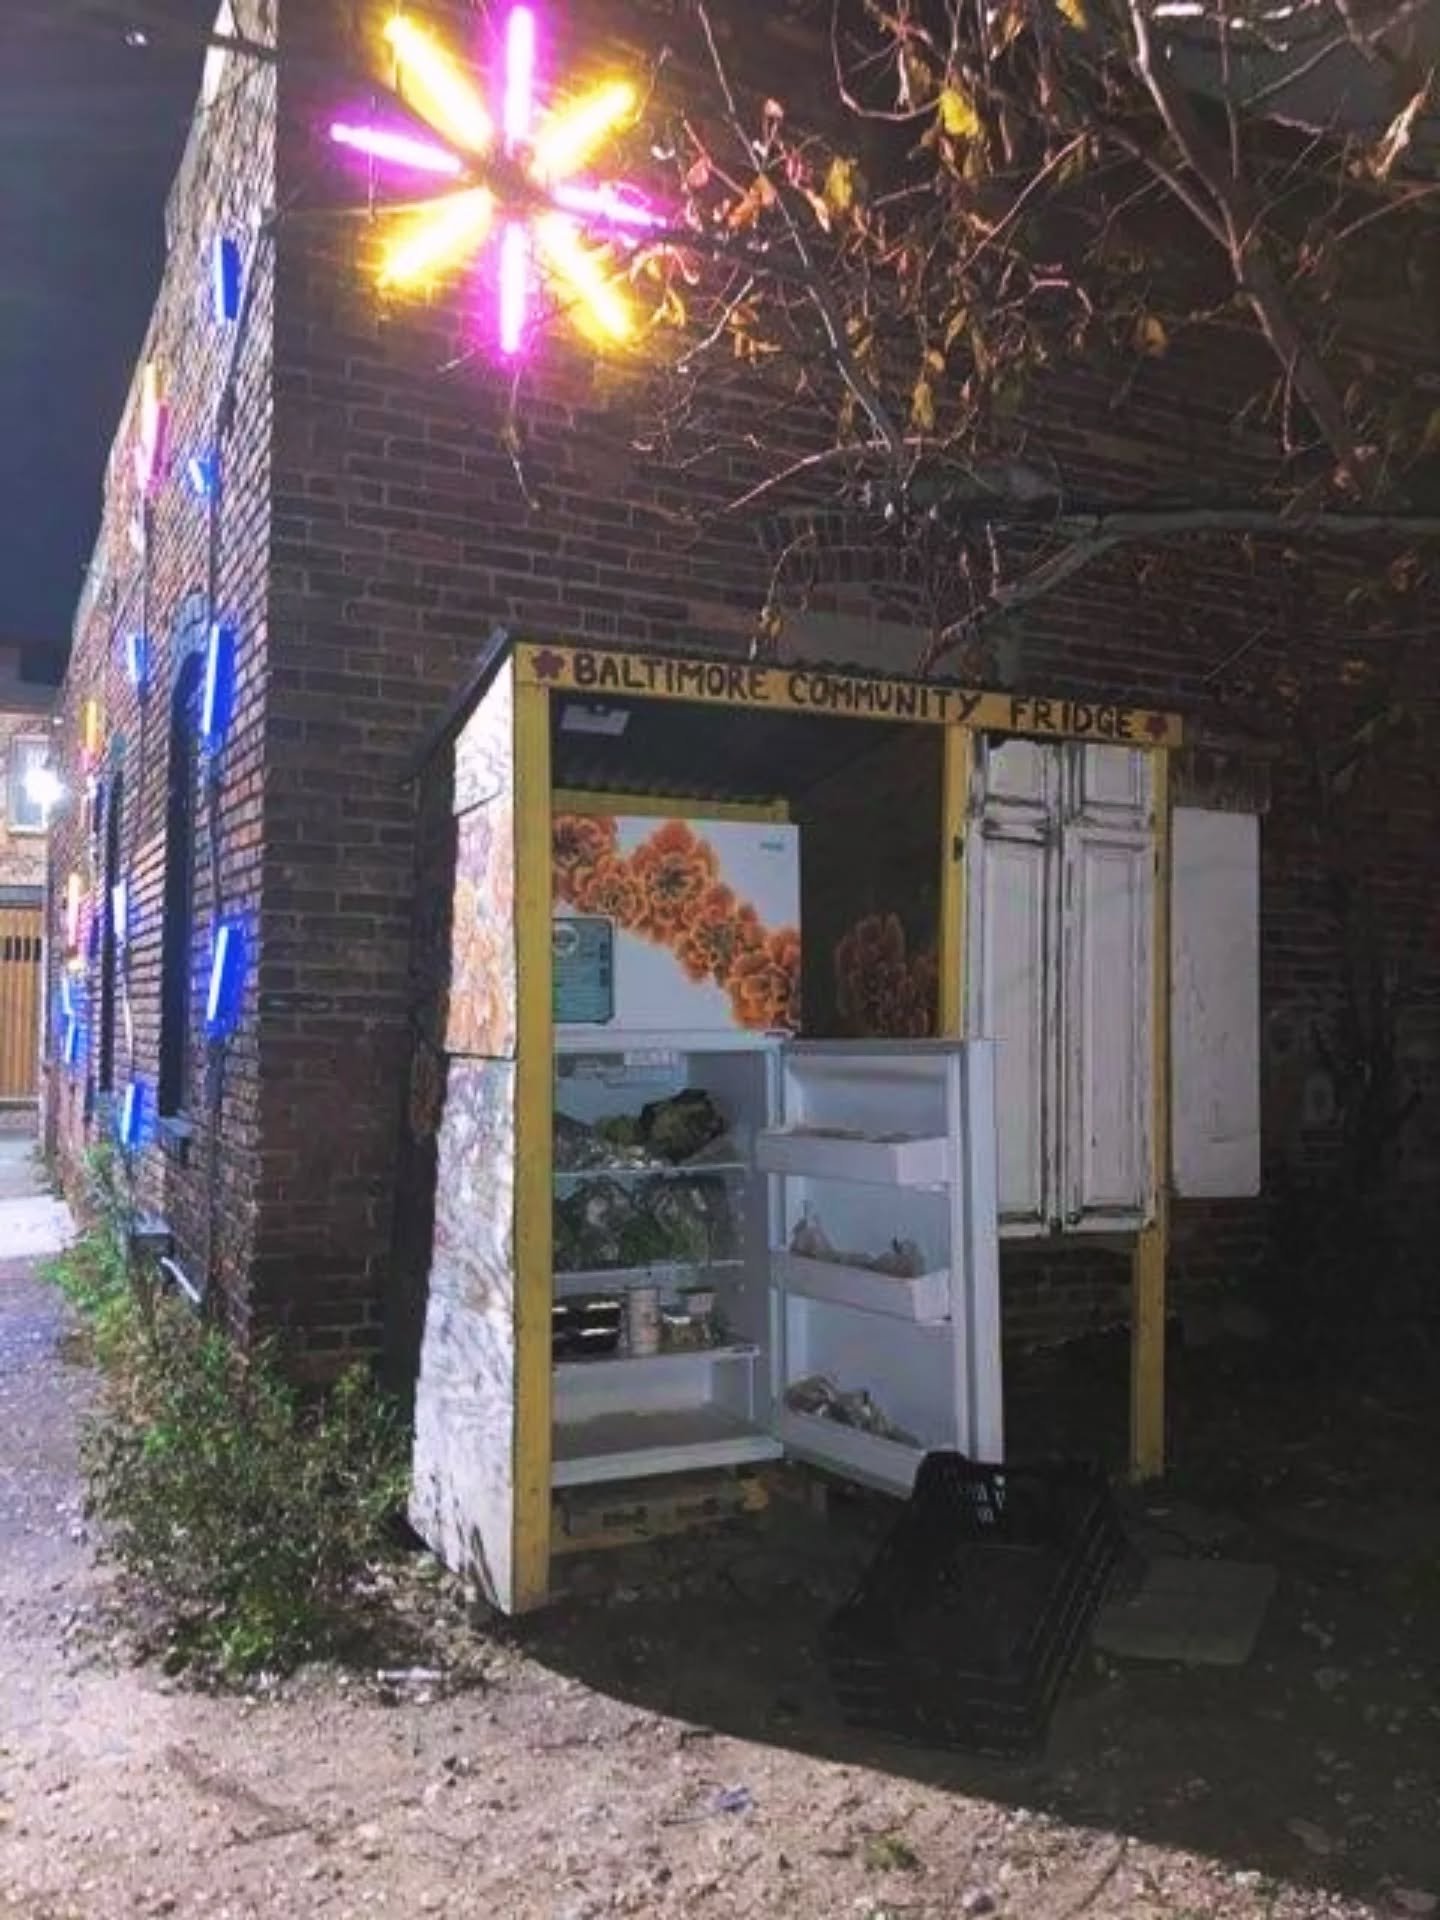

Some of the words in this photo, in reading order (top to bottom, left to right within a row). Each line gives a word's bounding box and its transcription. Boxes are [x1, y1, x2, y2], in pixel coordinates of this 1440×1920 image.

[572, 653, 770, 700] BALTIMORE
[787, 674, 981, 722] COMMUNITY
[1010, 698, 1134, 738] FRIDGE
